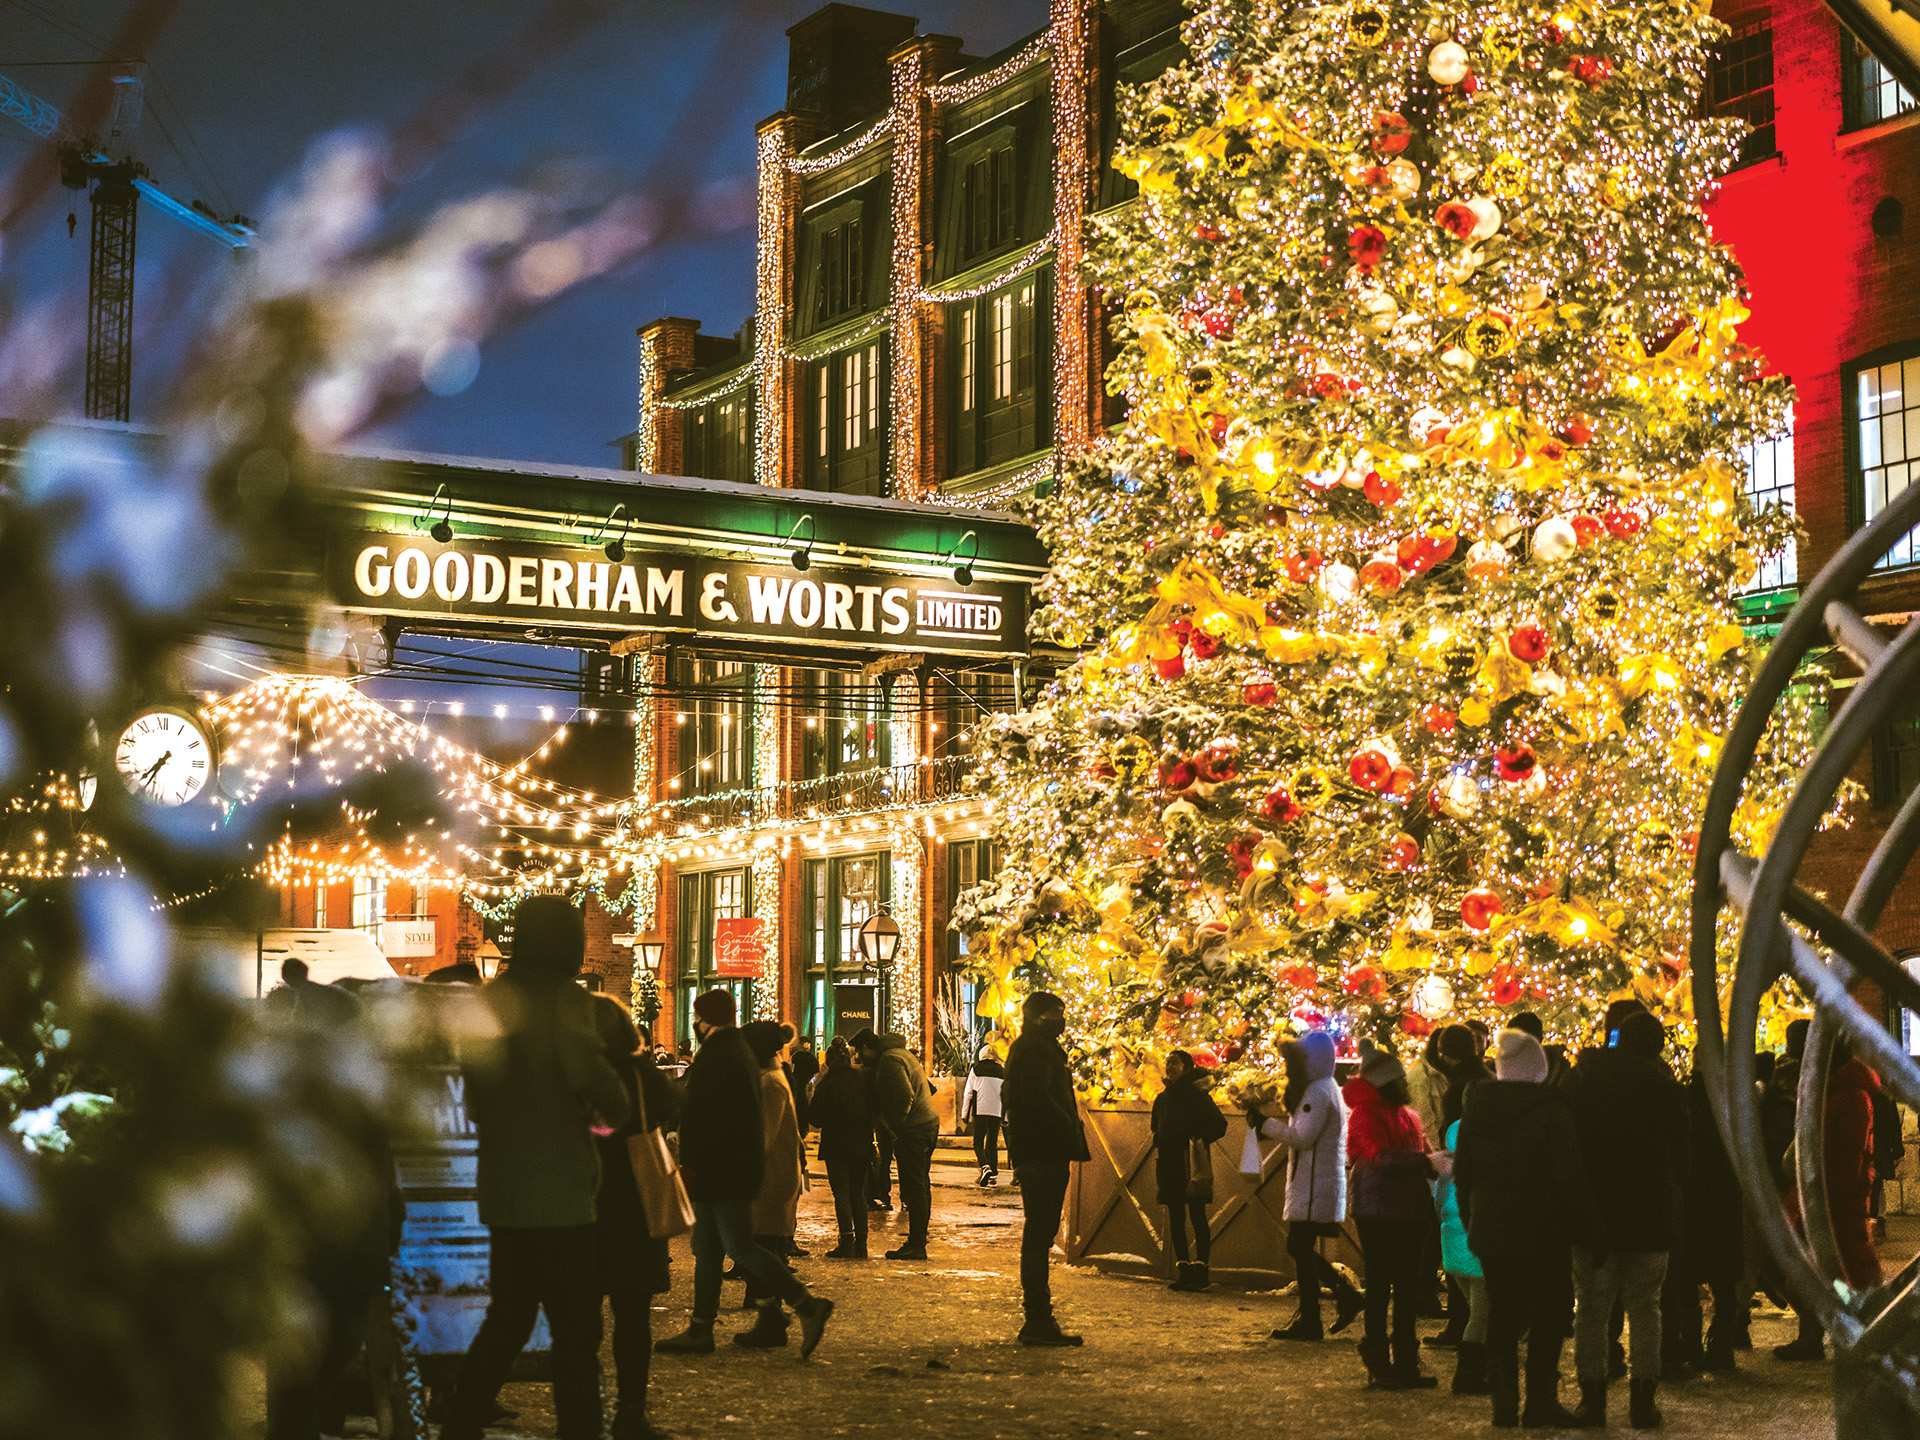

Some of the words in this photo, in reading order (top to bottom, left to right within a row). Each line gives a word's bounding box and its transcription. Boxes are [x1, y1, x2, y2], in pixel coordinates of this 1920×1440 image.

[354, 546, 685, 617] GOODERHAM
[699, 572, 740, 622] &
[745, 575, 910, 635] WORTS
[916, 599, 1002, 631] LIMITED
[841, 1010, 871, 1019] CHANEL
